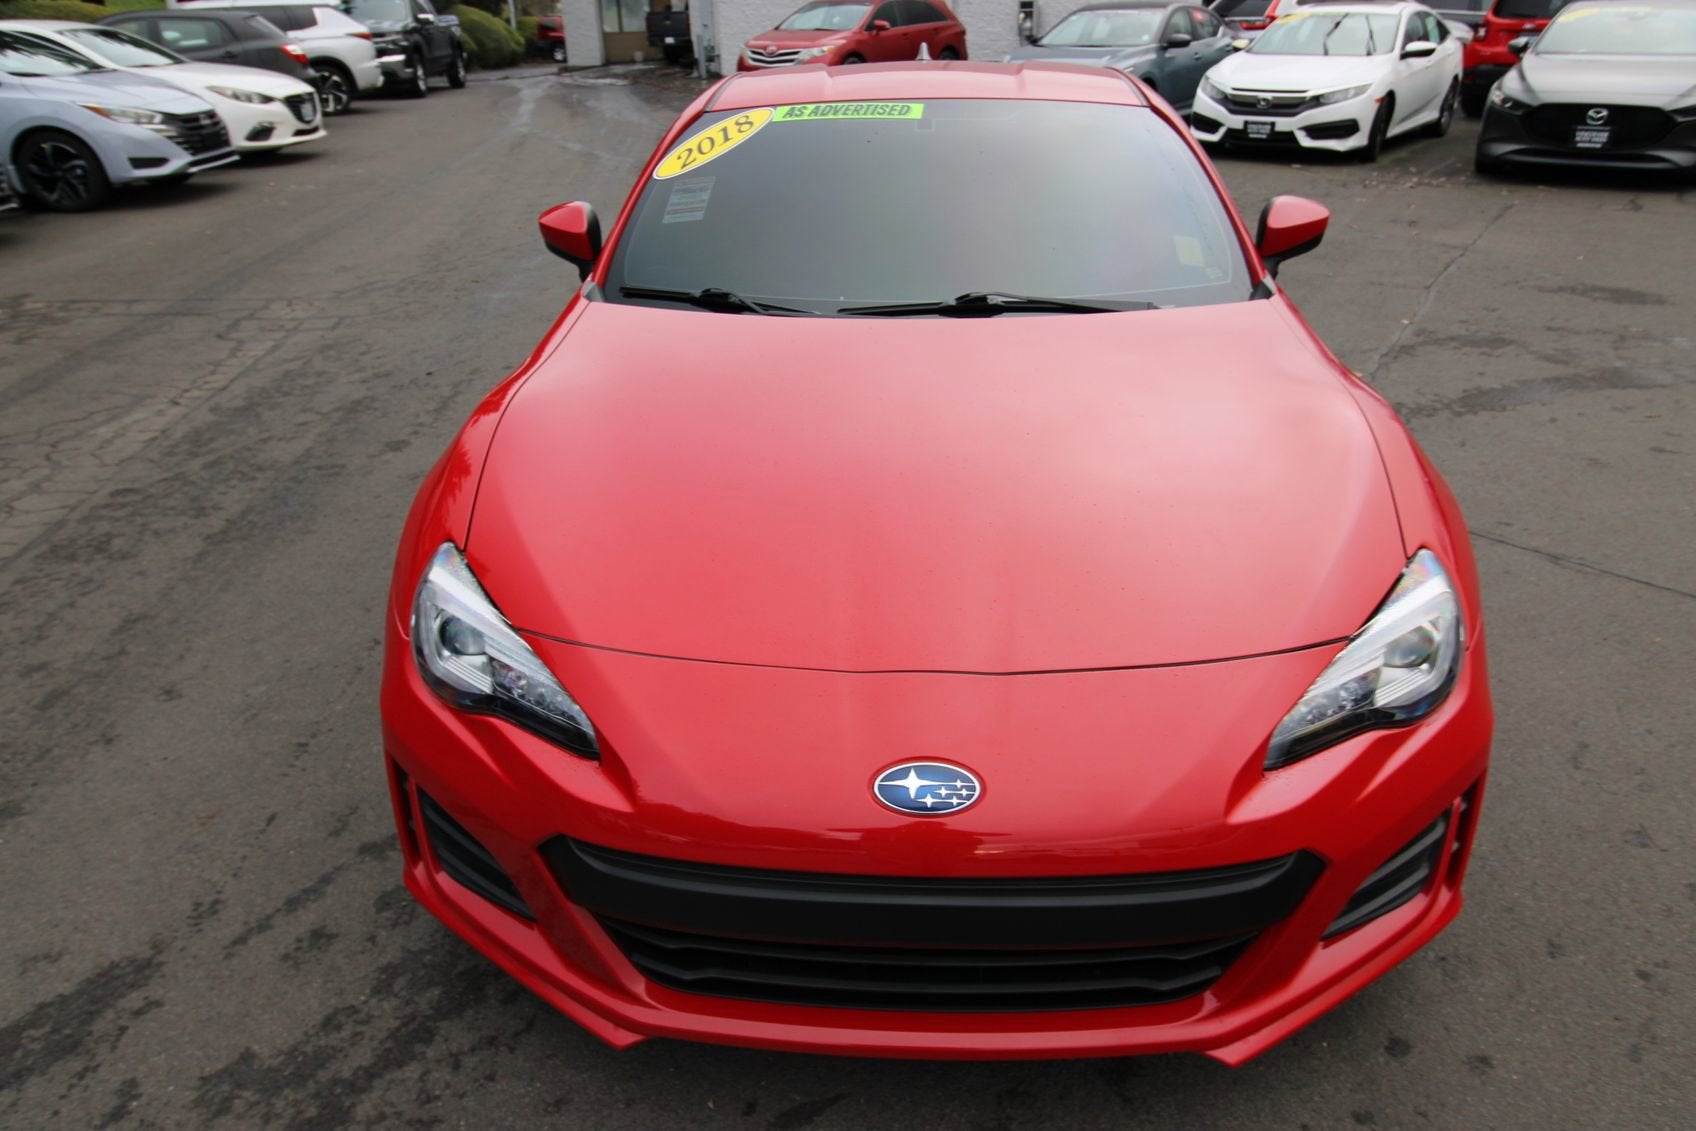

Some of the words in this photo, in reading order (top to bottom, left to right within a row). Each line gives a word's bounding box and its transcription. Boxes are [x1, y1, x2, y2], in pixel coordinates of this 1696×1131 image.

[783, 105, 807, 118] AS
[809, 103, 911, 118] ADVERTISED
[676, 115, 755, 169] 2018
